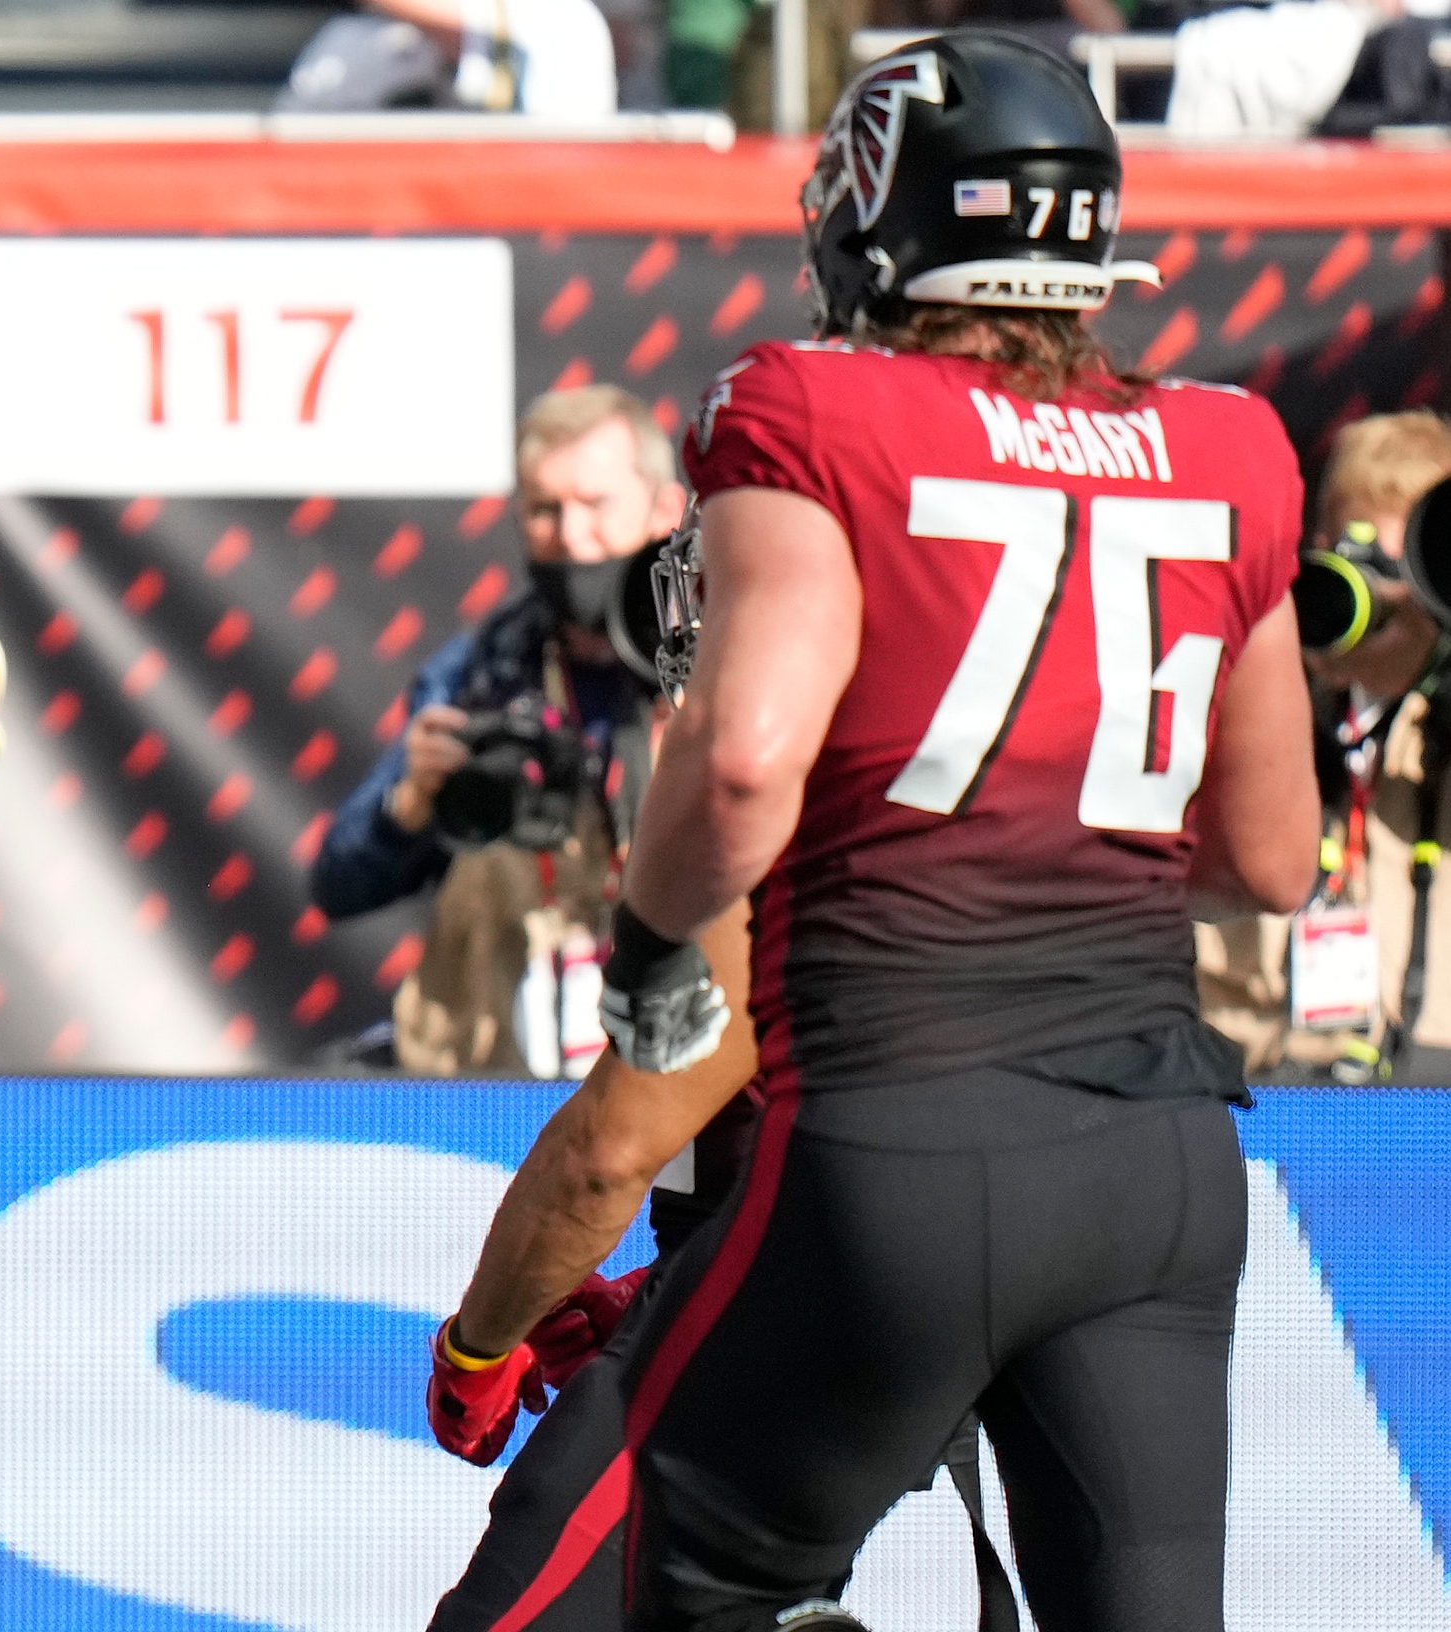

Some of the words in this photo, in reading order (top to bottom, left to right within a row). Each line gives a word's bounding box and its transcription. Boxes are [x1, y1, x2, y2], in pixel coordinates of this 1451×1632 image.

[1026, 187, 1097, 241] 76
[127, 308, 355, 424] 117
[969, 387, 1173, 483] McGARY
[885, 475, 1239, 834] 76
